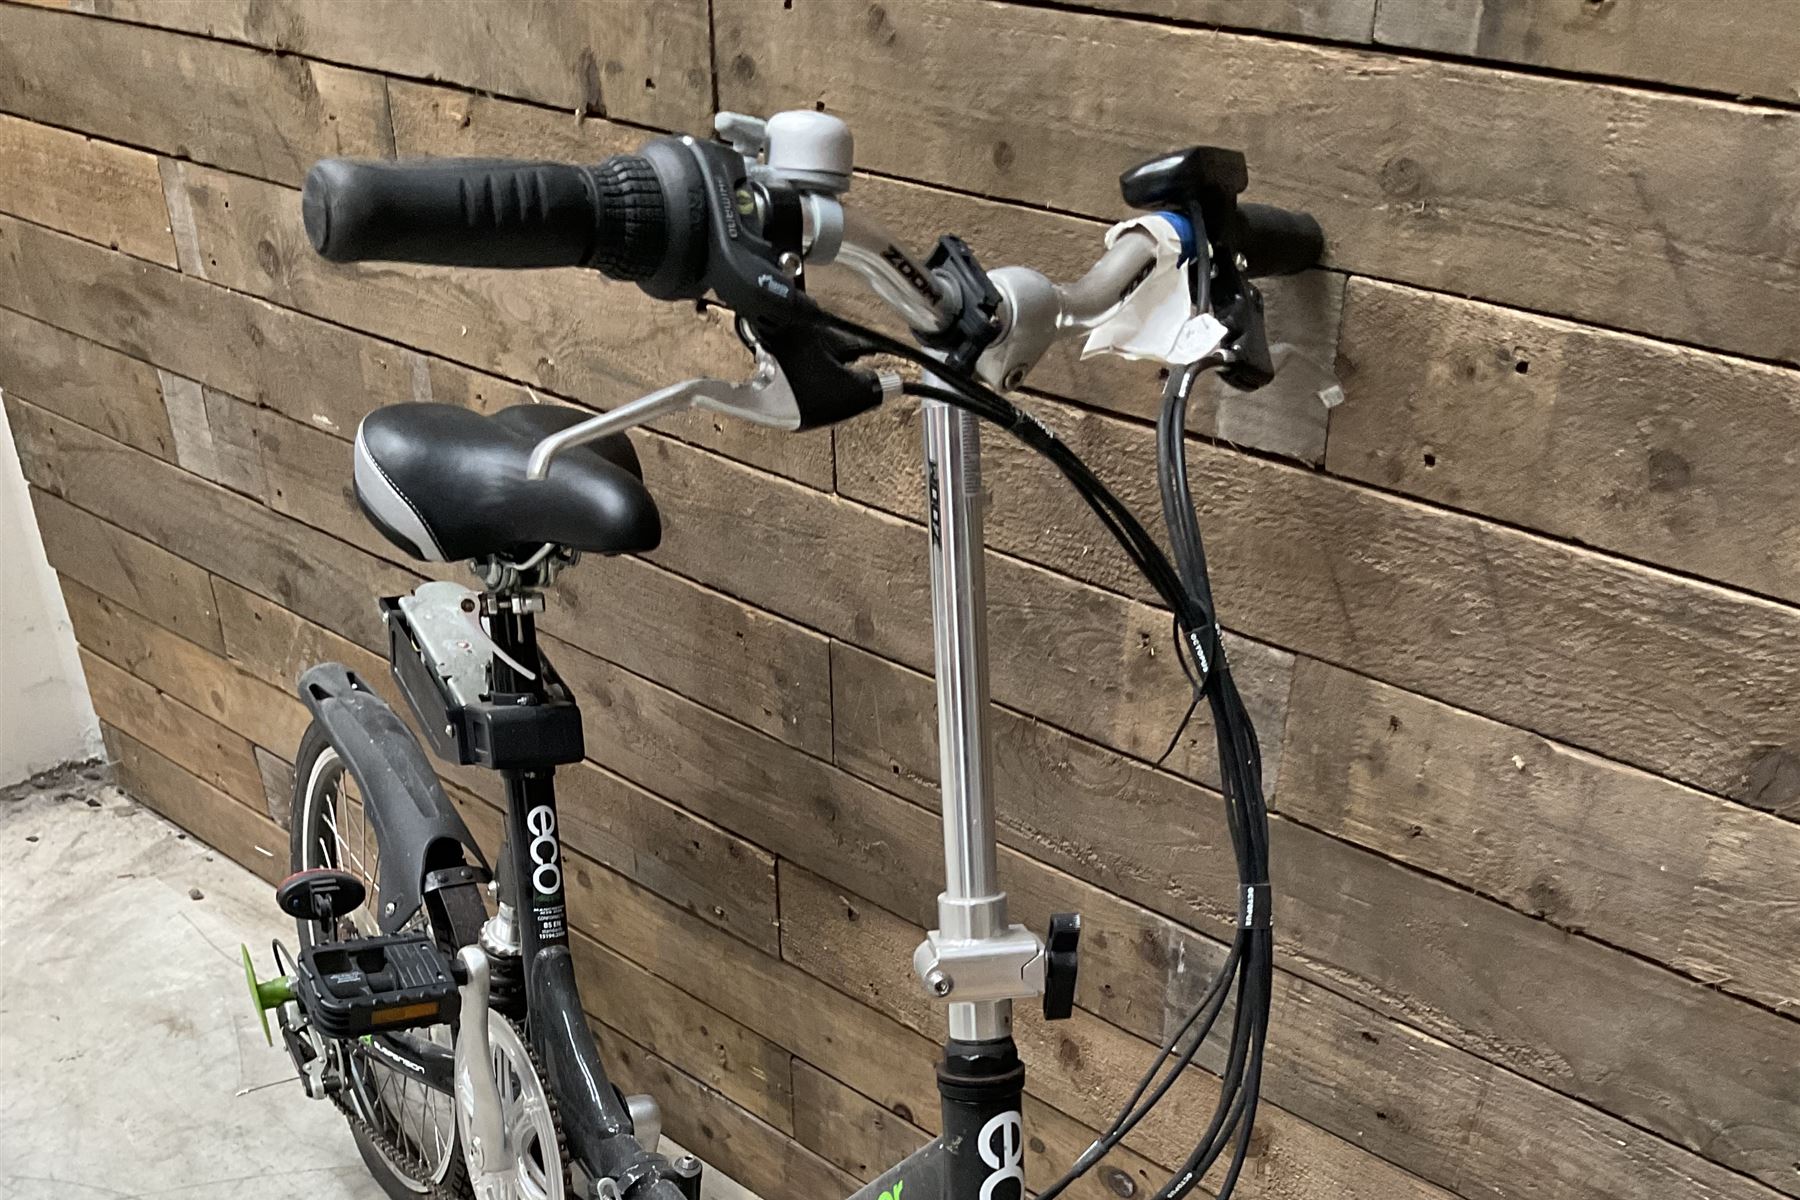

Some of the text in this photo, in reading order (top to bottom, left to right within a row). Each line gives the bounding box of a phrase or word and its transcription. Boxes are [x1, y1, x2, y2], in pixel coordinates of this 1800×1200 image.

[879, 242, 944, 307] ZOOM
[928, 461, 943, 552] ZOOM
[1190, 633, 1208, 673] OCTOPUS
[526, 805, 561, 895] eco
[1244, 886, 1255, 927] OCTOPUS
